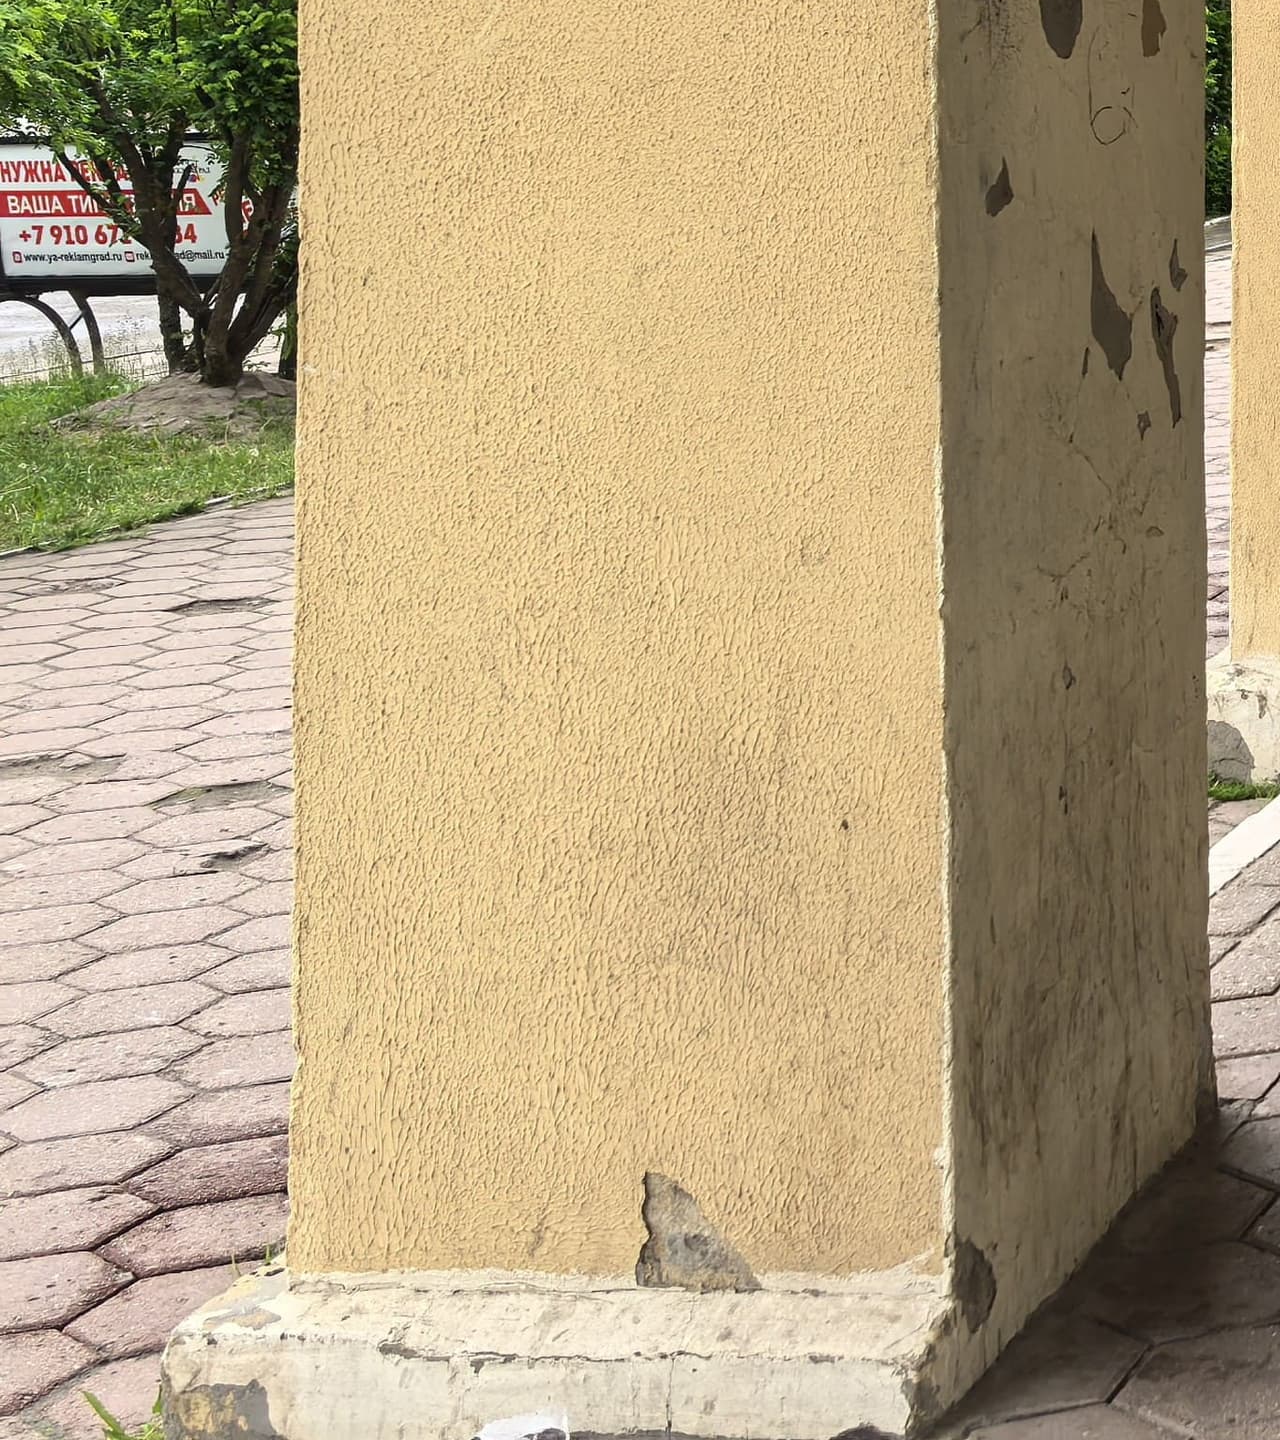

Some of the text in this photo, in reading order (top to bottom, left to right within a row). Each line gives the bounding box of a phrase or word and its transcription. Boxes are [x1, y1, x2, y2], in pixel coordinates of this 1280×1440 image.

[0, 160, 66, 182] НУЖНА
[7, 194, 65, 214] ВАША
[19, 225, 44, 245] +7
[50, 224, 88, 245] 910
[95, 224, 132, 244] 67
